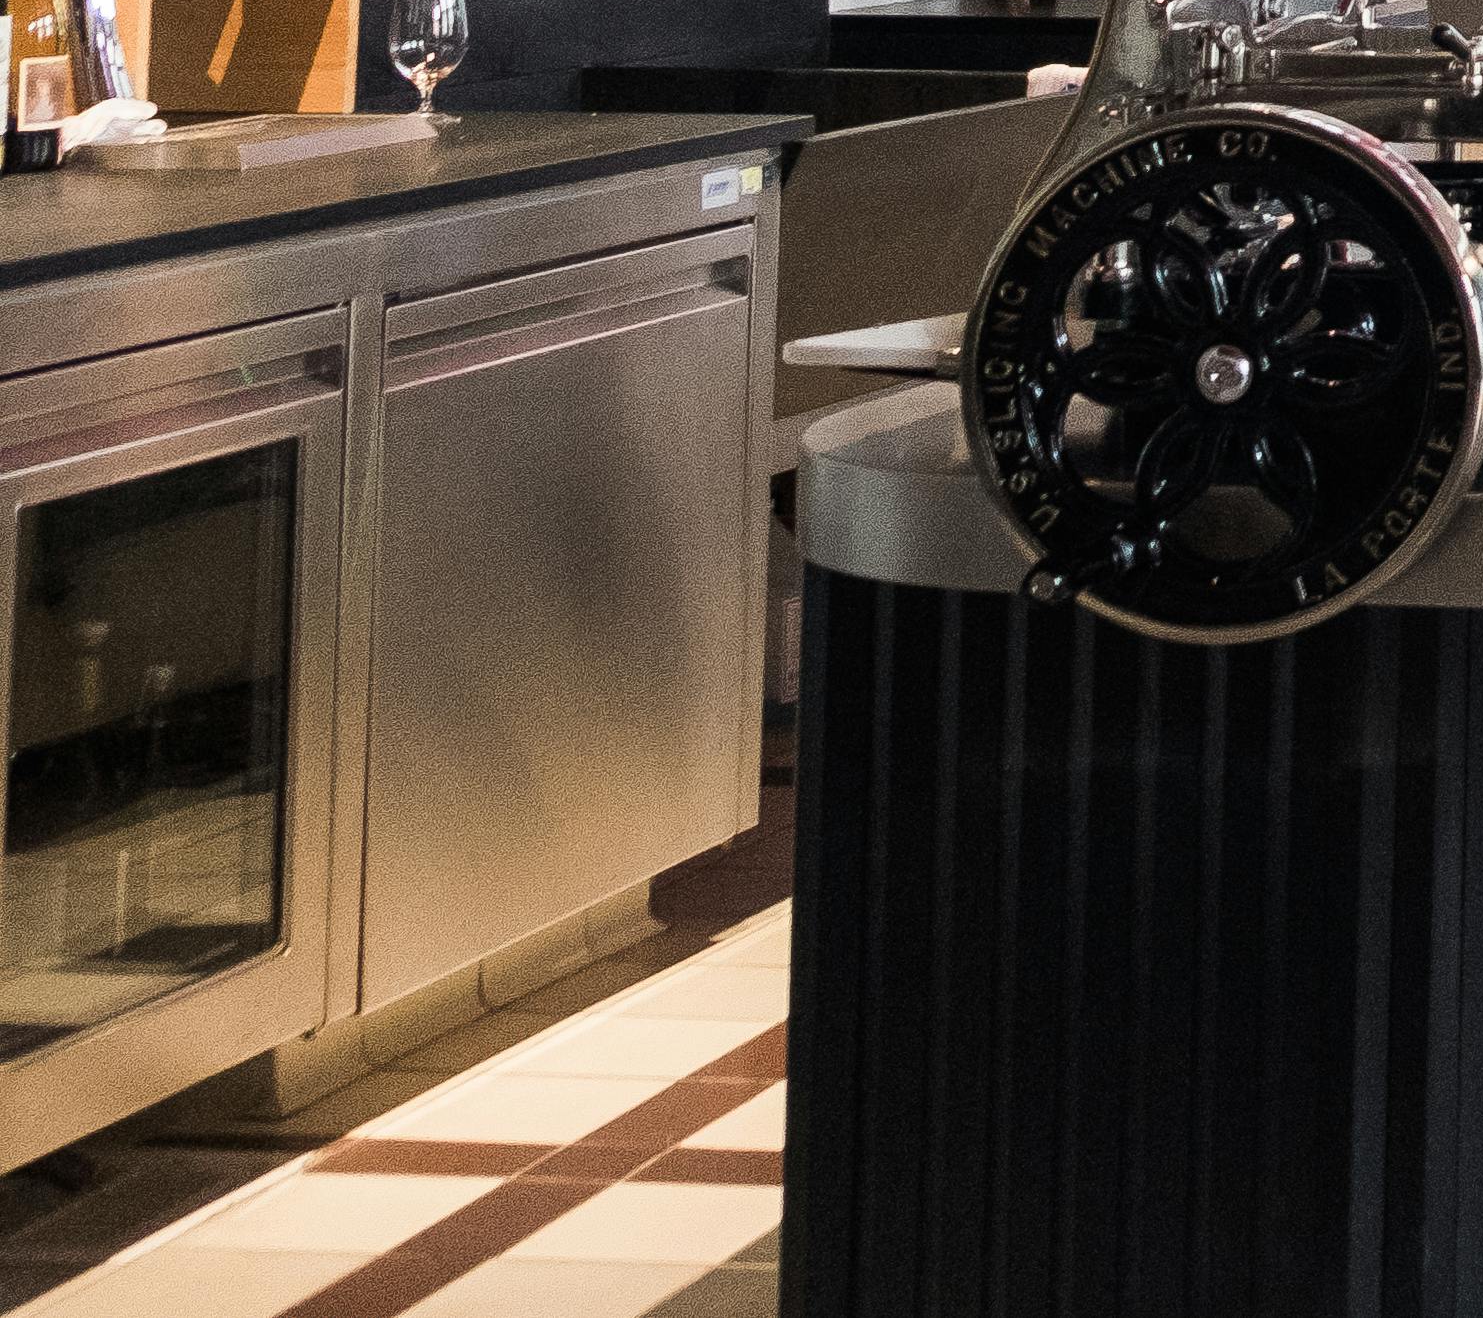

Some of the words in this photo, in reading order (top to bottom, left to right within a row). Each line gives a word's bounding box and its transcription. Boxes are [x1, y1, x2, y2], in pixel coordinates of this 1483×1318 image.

[1026, 132, 1193, 259] MACHINE
[1218, 130, 1278, 162] CO.
[1360, 428, 1453, 560] PORTE
